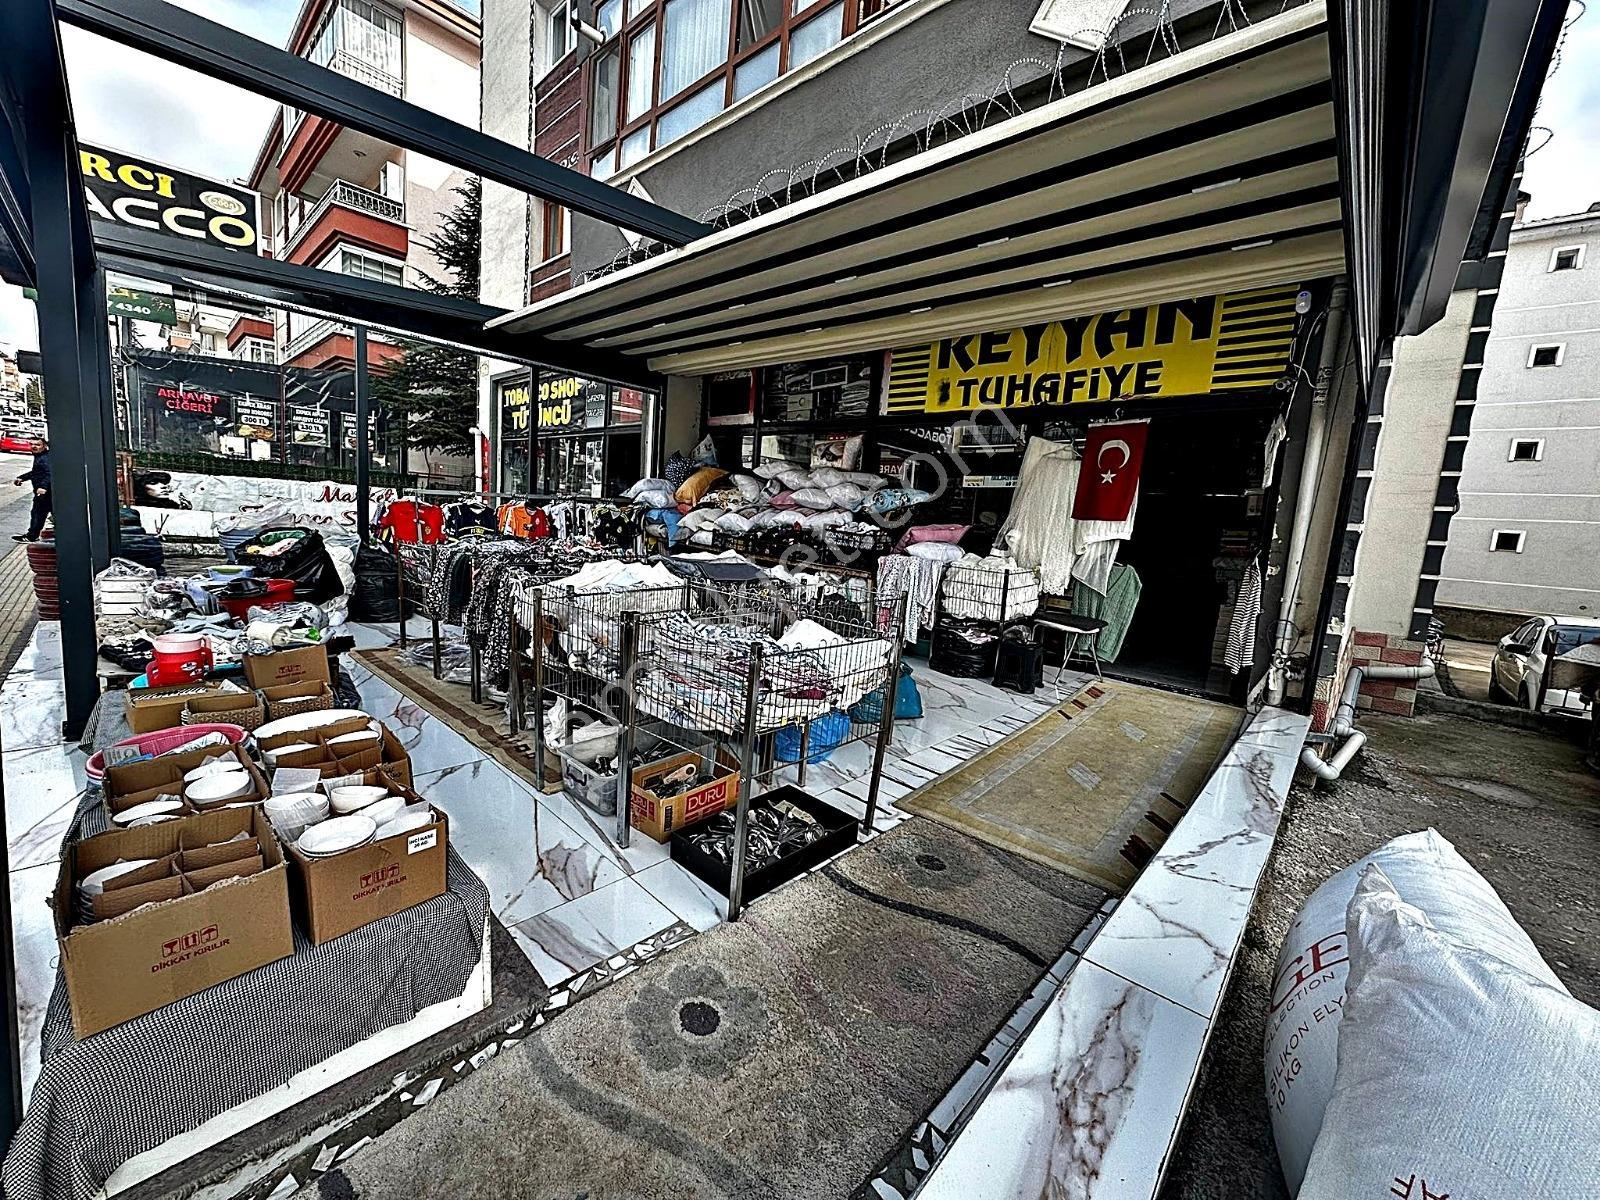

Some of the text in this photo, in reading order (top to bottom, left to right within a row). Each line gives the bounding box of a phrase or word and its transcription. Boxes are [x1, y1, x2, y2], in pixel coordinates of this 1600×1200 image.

[937, 296, 1217, 373] KEYYAN
[503, 382, 549, 408] TOBAO
[511, 399, 571, 430] TÜNCÜ
[313, 485, 395, 503] Maket
[689, 786, 725, 810] DURU
[352, 884, 380, 901] DİKKAT
[151, 938, 230, 973] DİKKAT KIRILIR
[1284, 1058, 1302, 1090] KG
